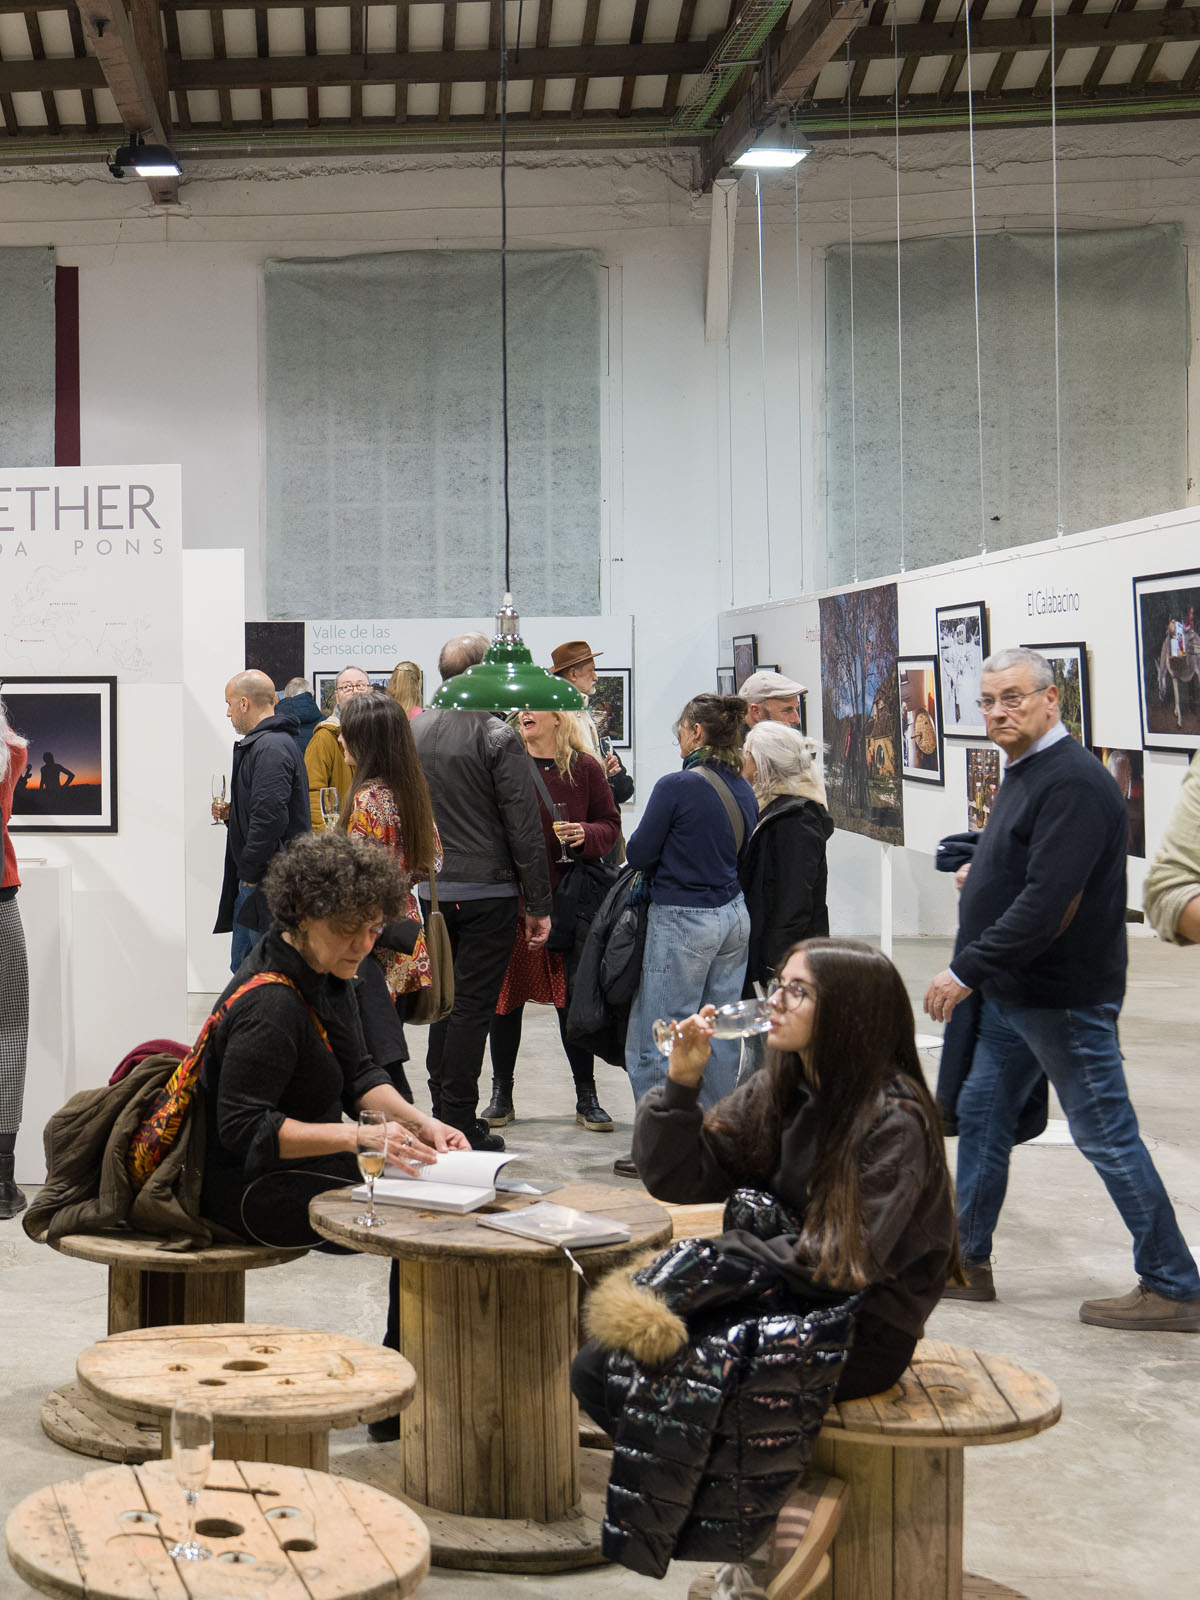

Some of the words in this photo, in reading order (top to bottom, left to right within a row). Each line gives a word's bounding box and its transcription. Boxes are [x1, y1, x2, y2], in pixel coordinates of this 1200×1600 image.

[73, 538, 164, 556] PONS
[1035, 586, 1080, 615] Calabacino
[312, 624, 347, 639] Valle
[350, 623, 368, 639] de
[372, 623, 392, 639] las
[312, 641, 398, 655] Sensaciones
